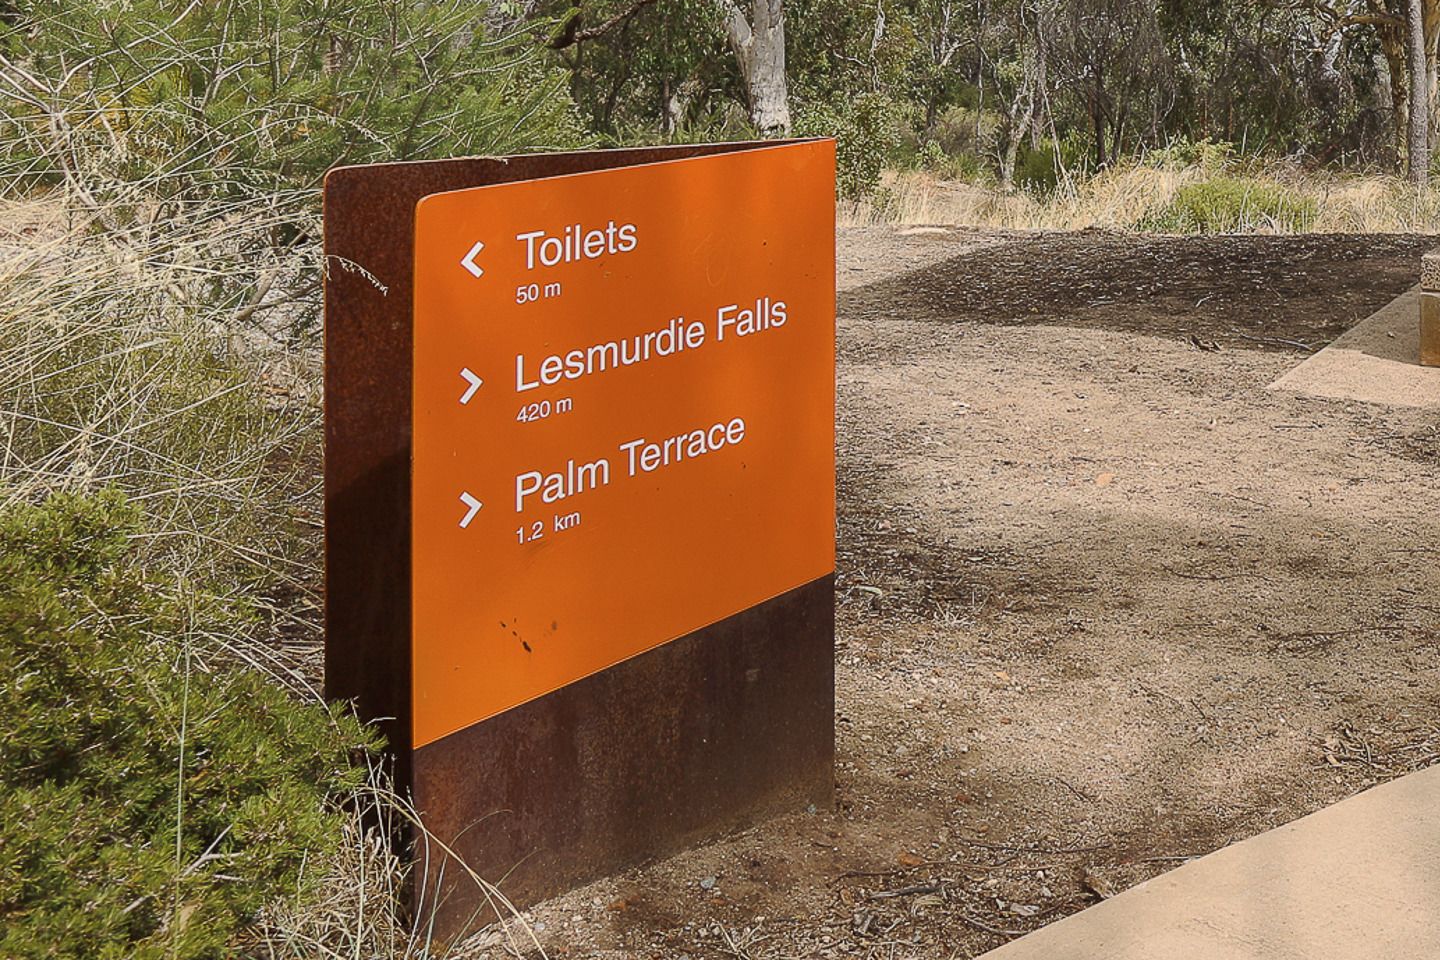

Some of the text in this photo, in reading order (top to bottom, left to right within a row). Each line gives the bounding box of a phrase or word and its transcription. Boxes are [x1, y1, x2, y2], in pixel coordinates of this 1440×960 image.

[516, 221, 638, 270] Toilets
[516, 281, 561, 304] 50 m
[514, 297, 788, 392] Lesmurdie Falls
[516, 396, 572, 423] 420 m
[514, 416, 746, 513] Palm Terrace
[516, 510, 580, 544] 1.2 km
